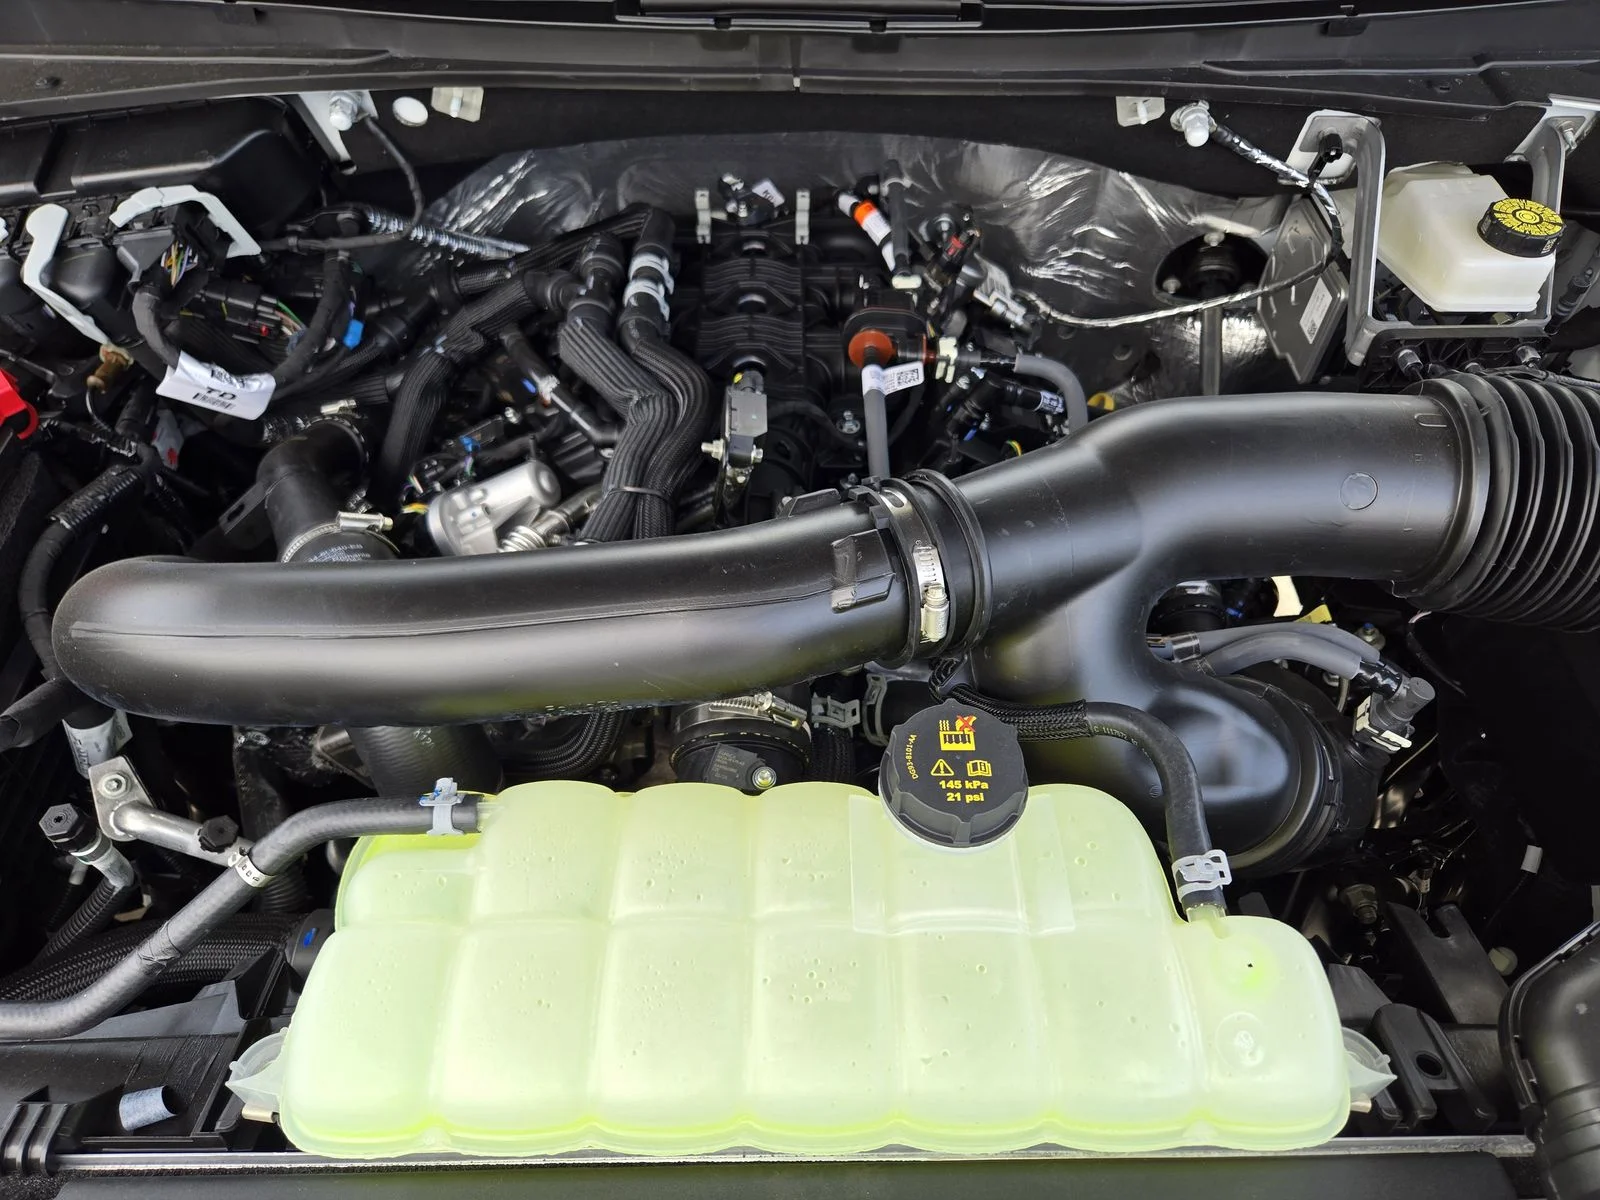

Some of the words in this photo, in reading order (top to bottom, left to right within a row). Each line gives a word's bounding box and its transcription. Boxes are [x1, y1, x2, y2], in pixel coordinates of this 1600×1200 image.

[905, 734, 918, 779] DG93-8101-AA
[939, 780, 962, 789] 145
[965, 780, 989, 789] kPa
[947, 793, 962, 802] 21
[965, 793, 984, 803] psi
